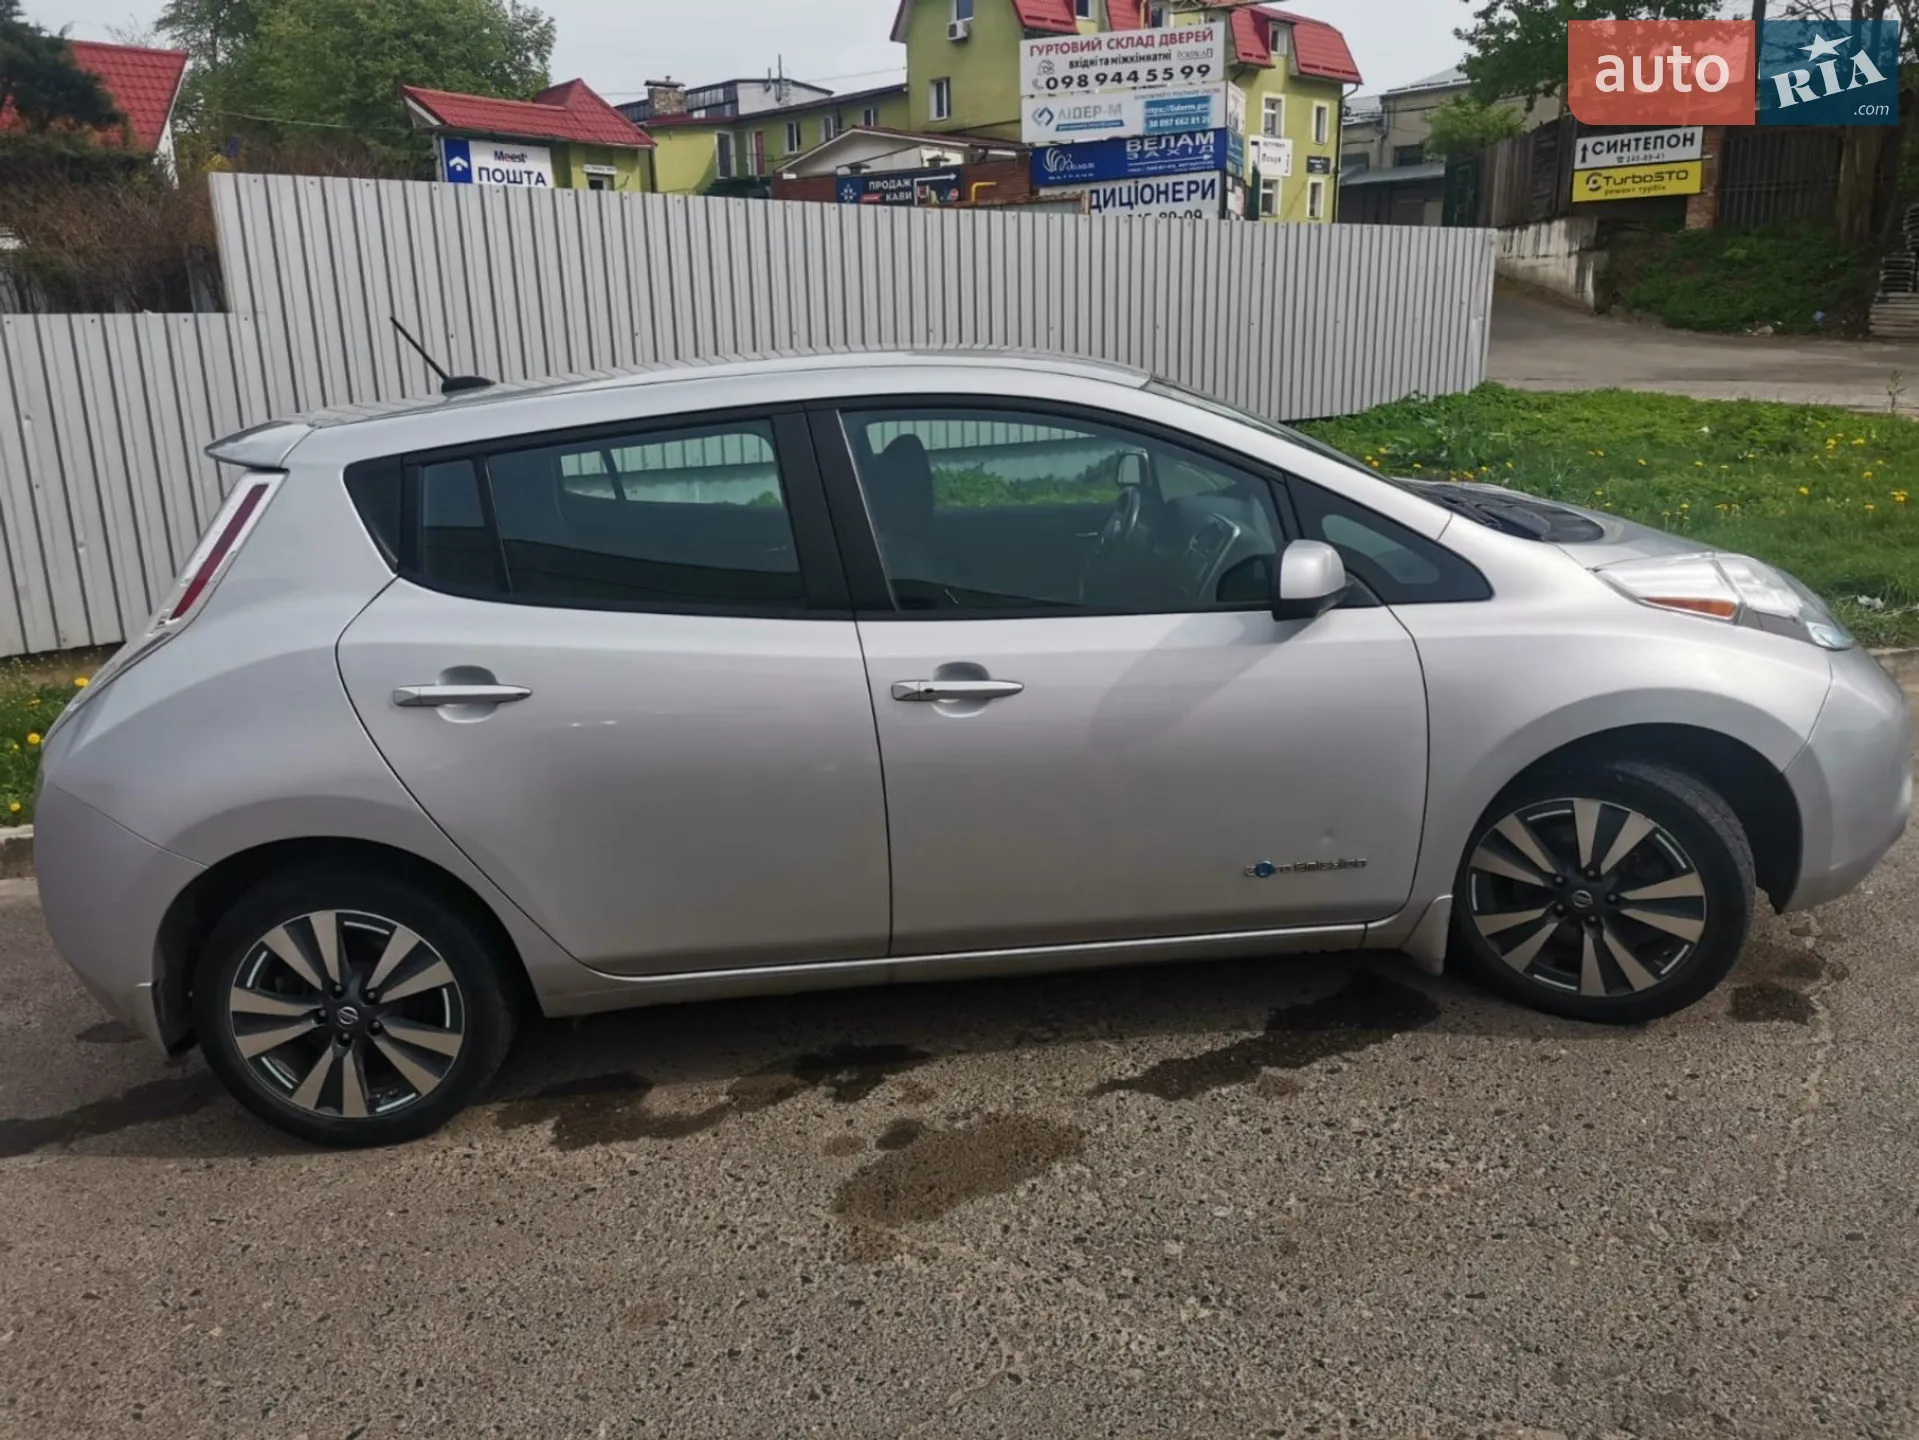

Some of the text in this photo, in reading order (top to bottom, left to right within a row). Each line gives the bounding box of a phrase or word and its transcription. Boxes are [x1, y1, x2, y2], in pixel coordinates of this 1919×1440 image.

[1030, 29, 1214, 57] ГУРТОВИЙ СКЛАД ДВЕРЕЙ
[1069, 56, 1098, 69] вхідні
[1100, 57, 1109, 66] та
[1111, 50, 1172, 65] міжкімнатні
[1126, 131, 1215, 152] ВЕЛАМ
[1592, 132, 1695, 155] СИНТЕПОН
[494, 150, 525, 163] Meest
[1127, 145, 1215, 160] ЗАХІД
[478, 166, 547, 186] ПОШТА
[869, 179, 912, 191] ПРОДАЖ
[1603, 169, 1689, 186] TurboSTO
[886, 192, 912, 202] КАВИ
